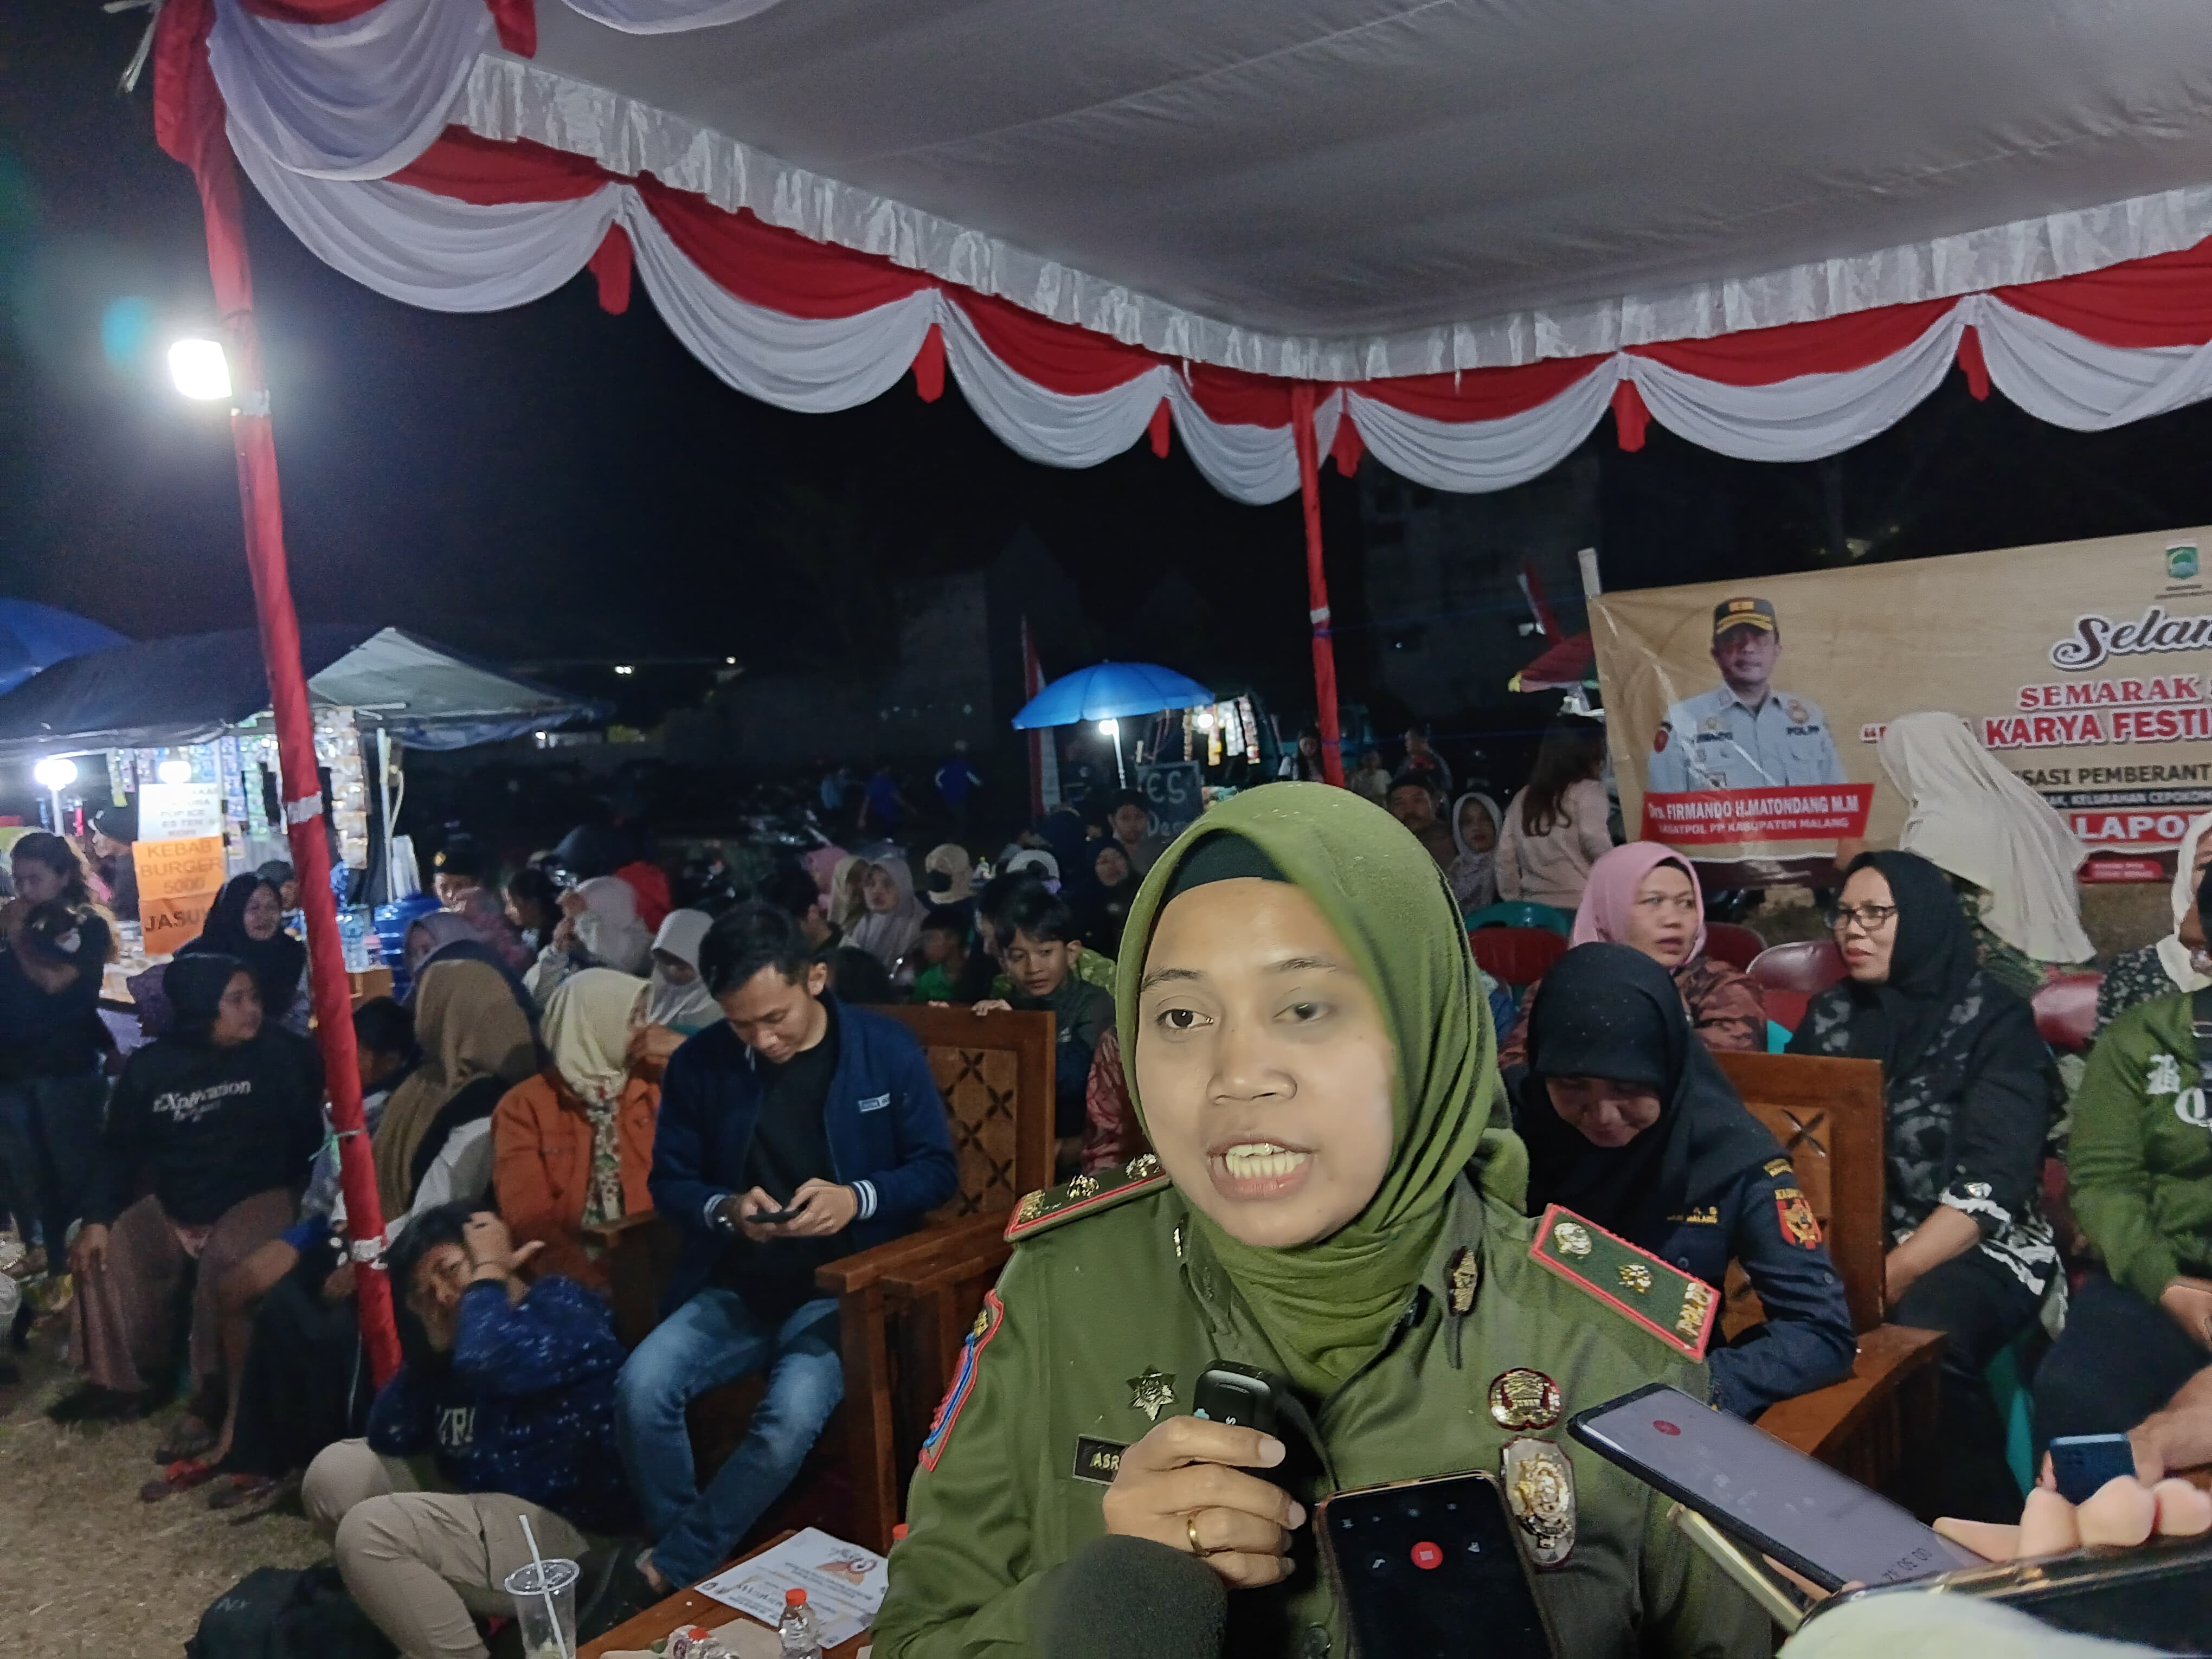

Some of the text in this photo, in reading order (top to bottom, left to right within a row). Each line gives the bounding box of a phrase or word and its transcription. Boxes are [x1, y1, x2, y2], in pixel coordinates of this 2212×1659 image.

[2019, 677, 2198, 708] SEMARAK
[1985, 708, 2212, 746] KARYA FESTI
[2078, 763, 2211, 784] PEMBERANT
[1667, 801, 1732, 820] FIRMANDO
[1728, 819, 1797, 833] KABUPATEN
[1799, 817, 1849, 829] MALANG
[2075, 814, 2201, 840] LAPO
[147, 840, 212, 858] KEBAB
[140, 857, 221, 878] BURGER
[164, 877, 205, 895] 5000
[145, 910, 208, 931] JASU
[1092, 1451, 1120, 1471] ASR
